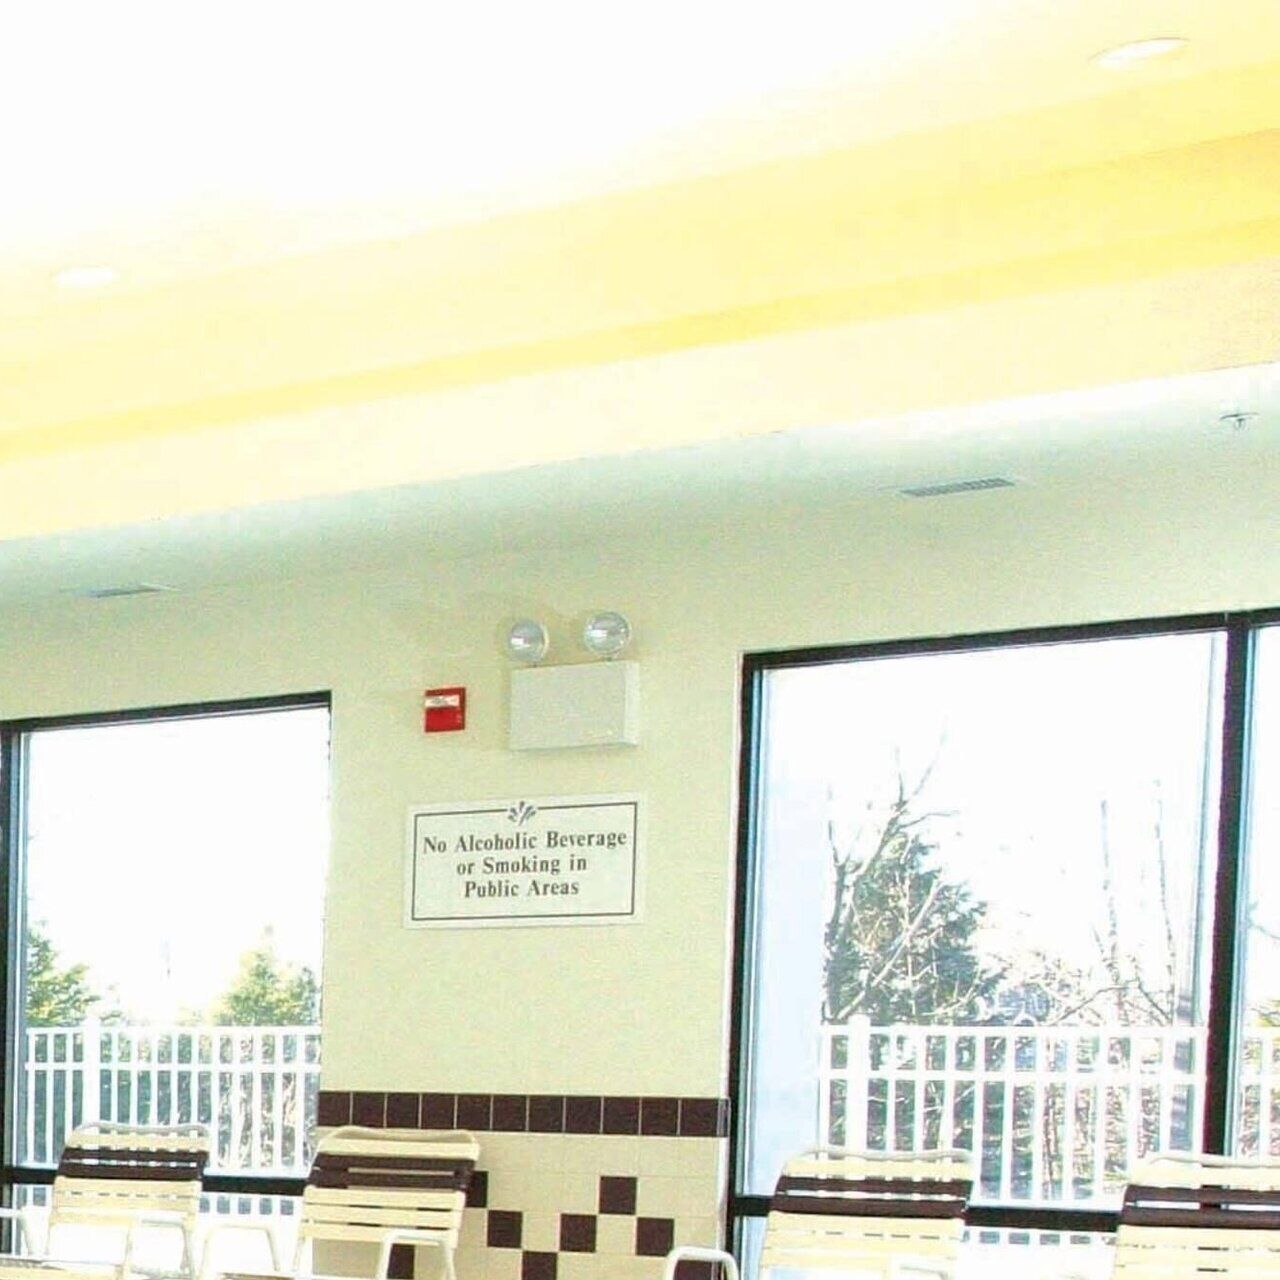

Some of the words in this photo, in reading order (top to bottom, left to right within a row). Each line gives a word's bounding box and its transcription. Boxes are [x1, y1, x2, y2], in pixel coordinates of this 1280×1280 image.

[423, 836, 447, 853] No
[455, 832, 538, 853] Alcoholic
[546, 831, 627, 849] Beverage
[456, 863, 475, 875] or
[483, 855, 561, 875] Smoking
[569, 854, 587, 871] in
[465, 880, 520, 898] Public
[527, 879, 579, 896] Areas
